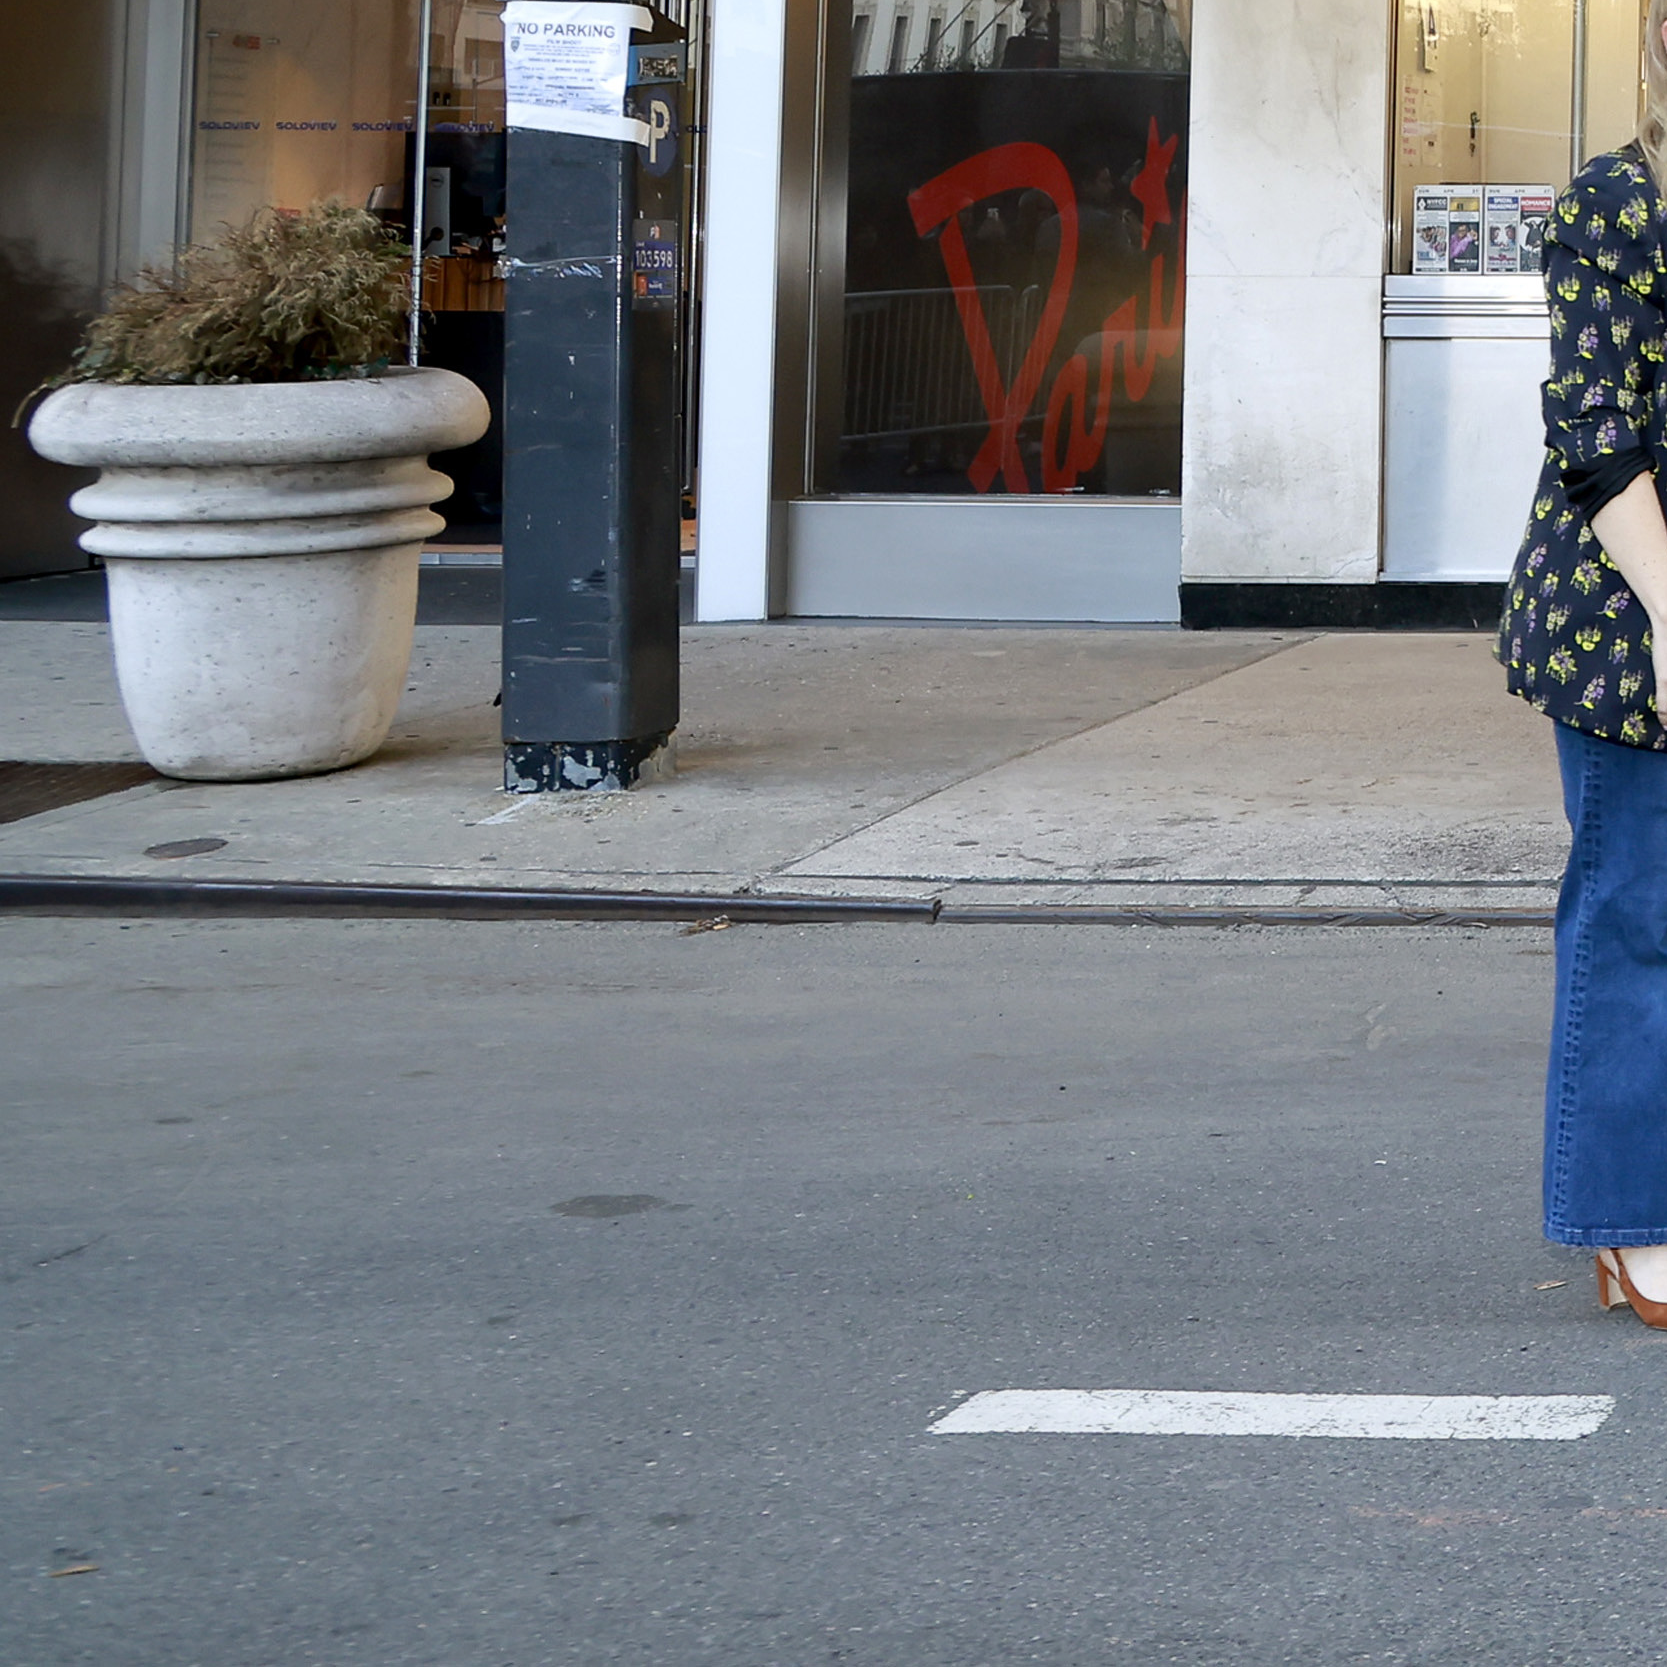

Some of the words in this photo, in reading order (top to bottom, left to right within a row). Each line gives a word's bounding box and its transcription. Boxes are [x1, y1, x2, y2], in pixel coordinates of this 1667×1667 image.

[517, 23, 538, 34] NO
[543, 23, 615, 38] PARKING
[650, 99, 670, 163] P
[636, 250, 673, 268] 103598
